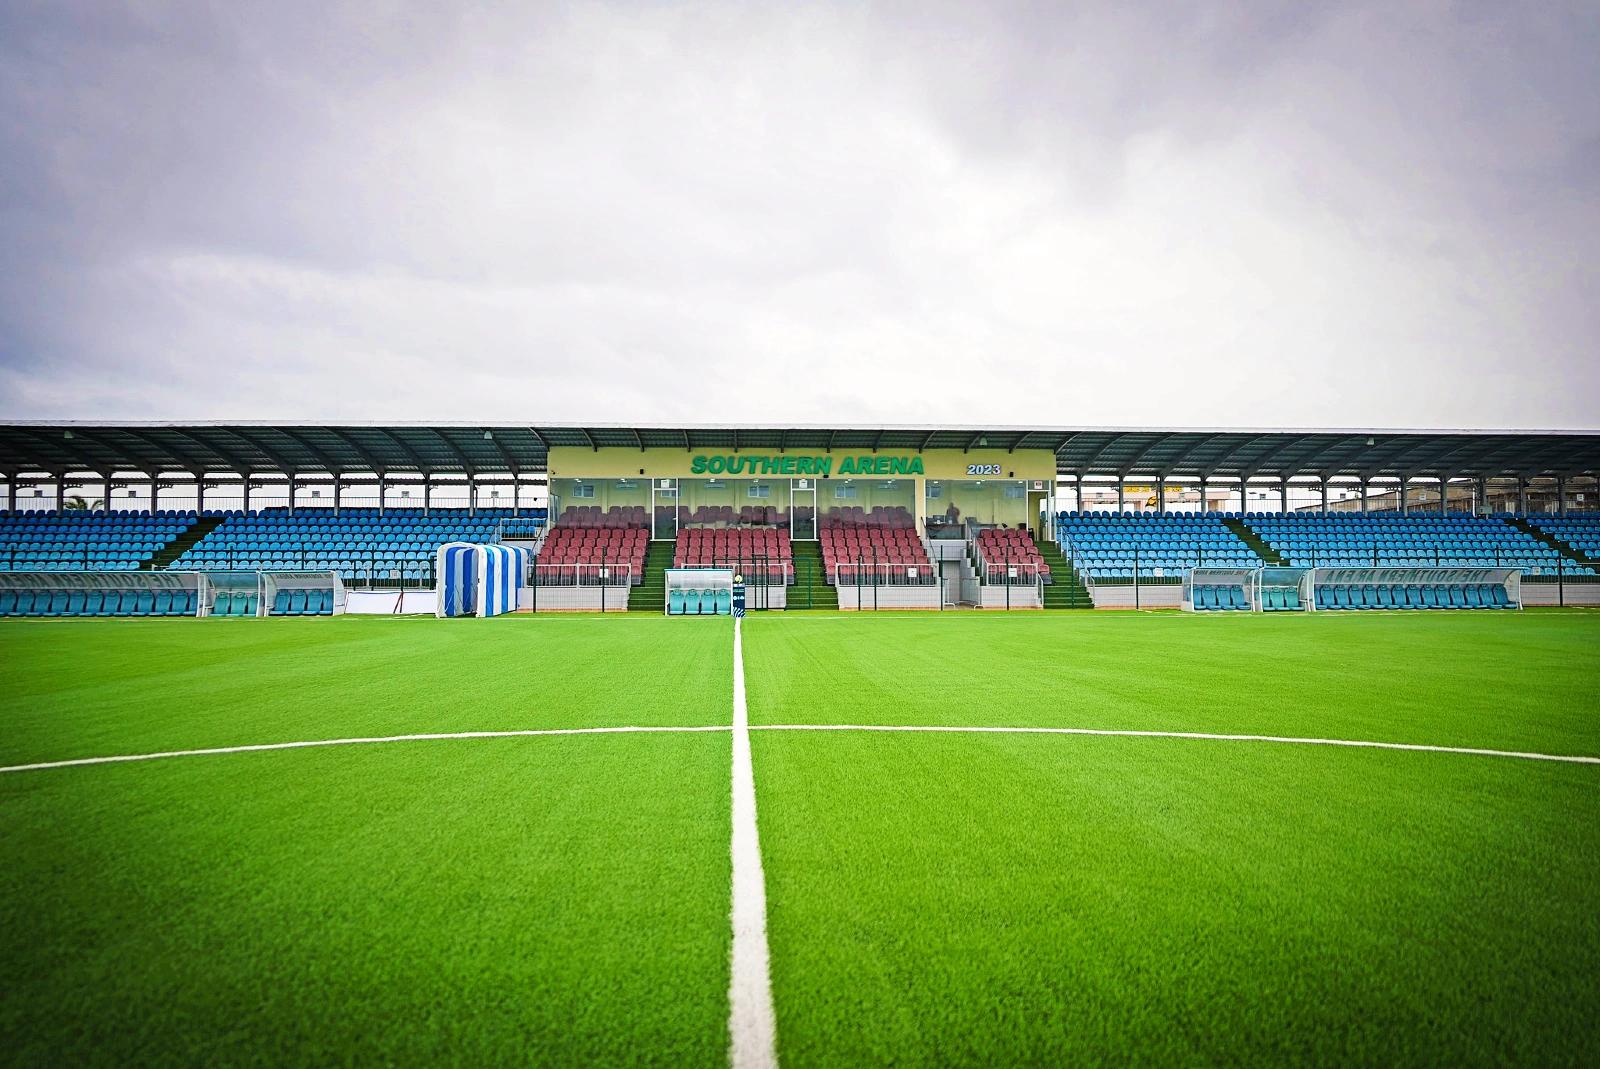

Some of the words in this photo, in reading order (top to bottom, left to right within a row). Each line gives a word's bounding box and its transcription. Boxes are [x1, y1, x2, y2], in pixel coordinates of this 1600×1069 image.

[691, 455, 832, 475] SOUTHERN
[838, 455, 924, 475] ARENA
[966, 463, 1001, 475] 2023
